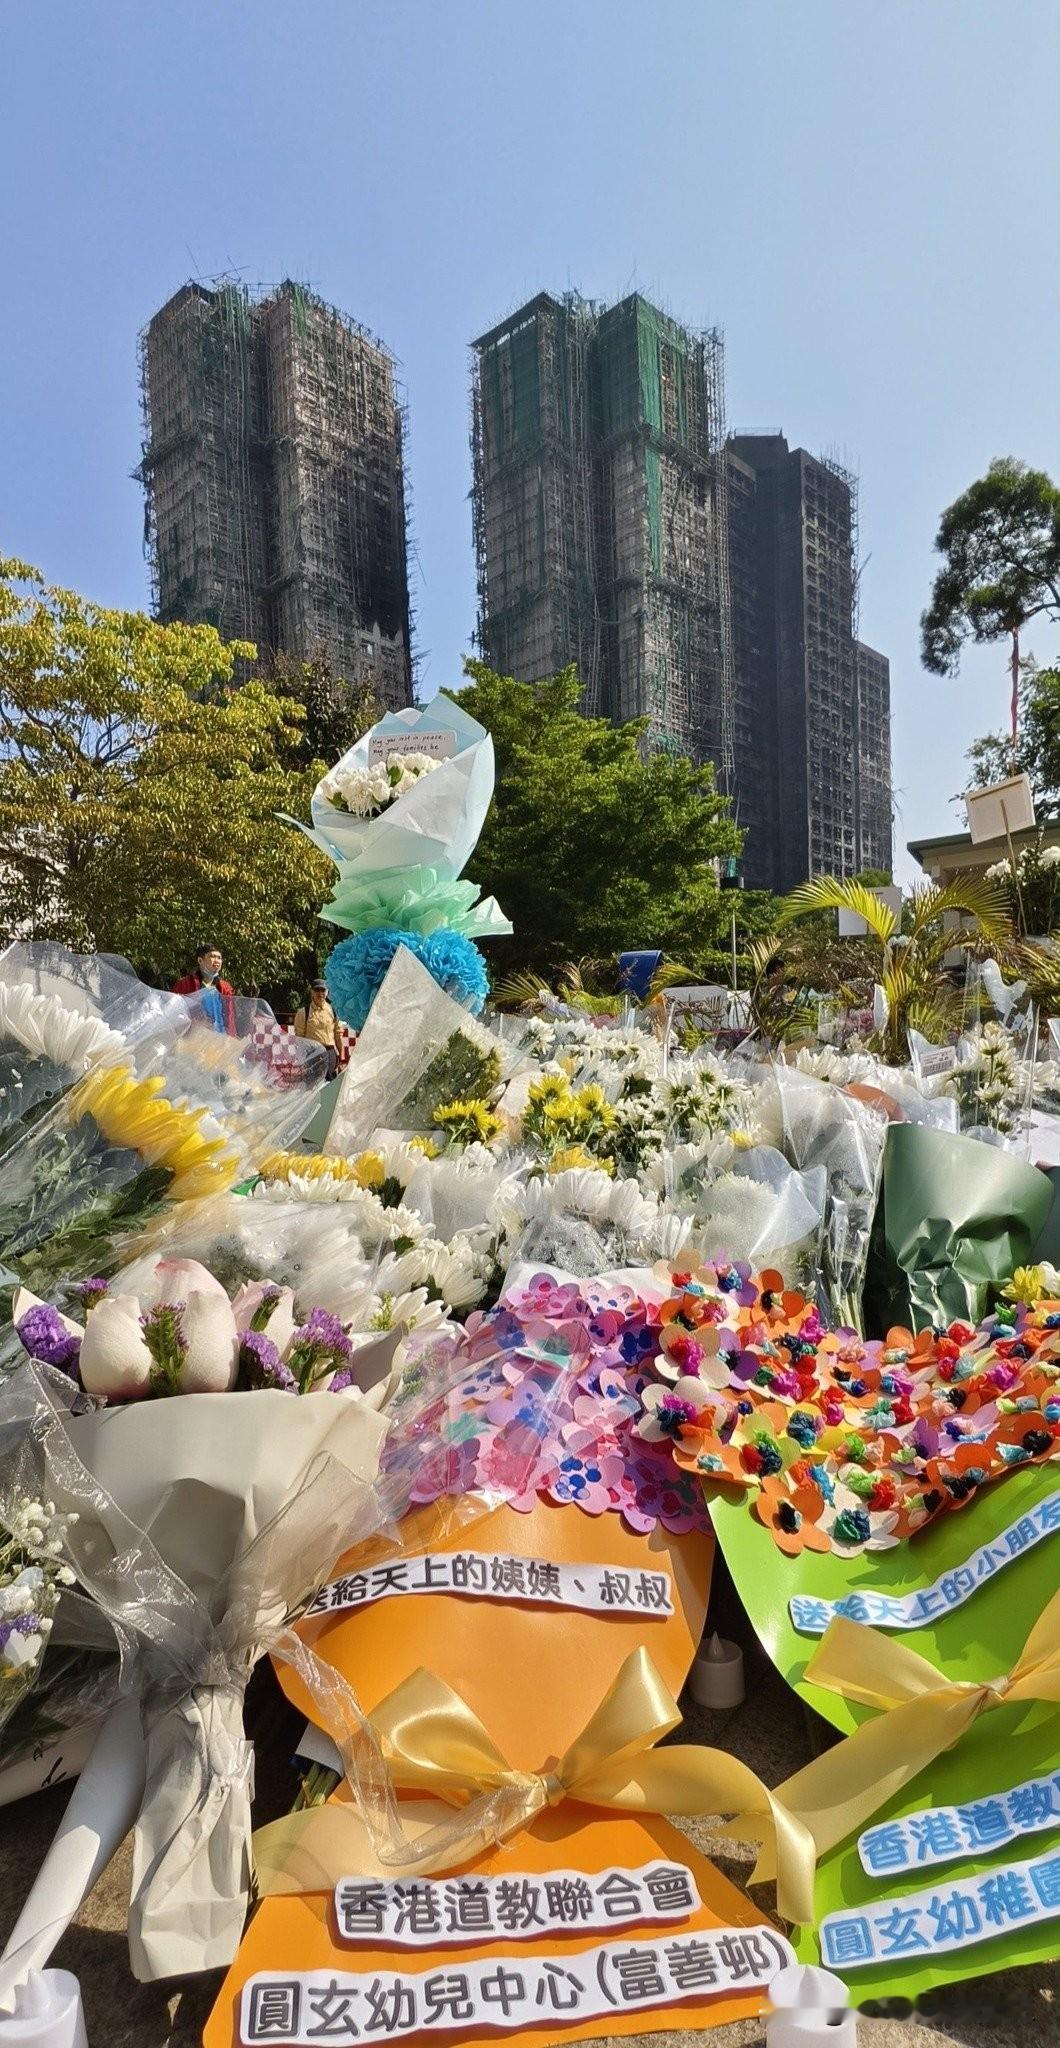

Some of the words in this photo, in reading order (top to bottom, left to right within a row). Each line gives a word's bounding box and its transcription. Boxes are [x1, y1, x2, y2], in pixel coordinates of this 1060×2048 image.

[862, 1776, 1060, 1870] 香港道教
[340, 1866, 693, 1934] 香港道教聯合會
